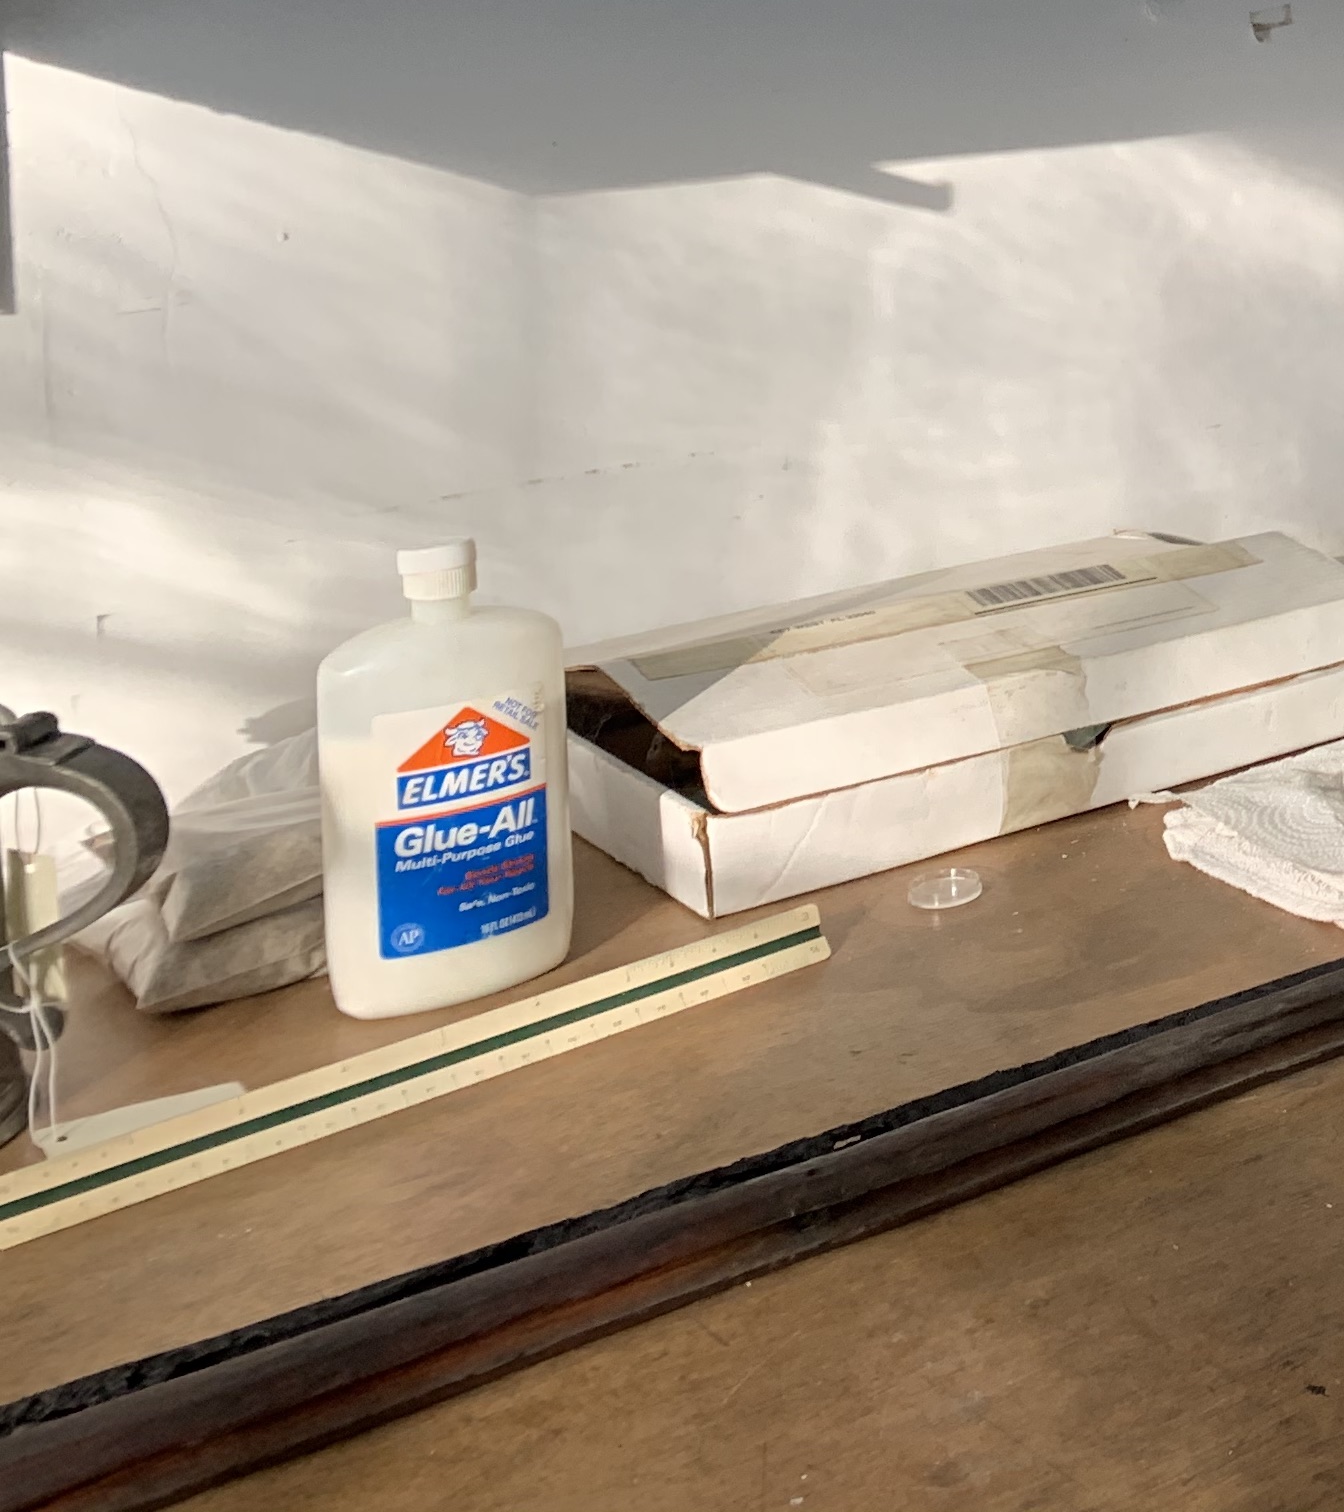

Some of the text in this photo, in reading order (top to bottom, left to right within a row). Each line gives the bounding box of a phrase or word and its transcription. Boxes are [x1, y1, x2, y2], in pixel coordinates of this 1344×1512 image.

[504, 696, 539, 720] NOT FOR
[402, 753, 526, 806] ELMER'S
[394, 797, 536, 858] Glue-All
[395, 830, 535, 873] Multi-Purpose Glue
[398, 928, 421, 946] AP
